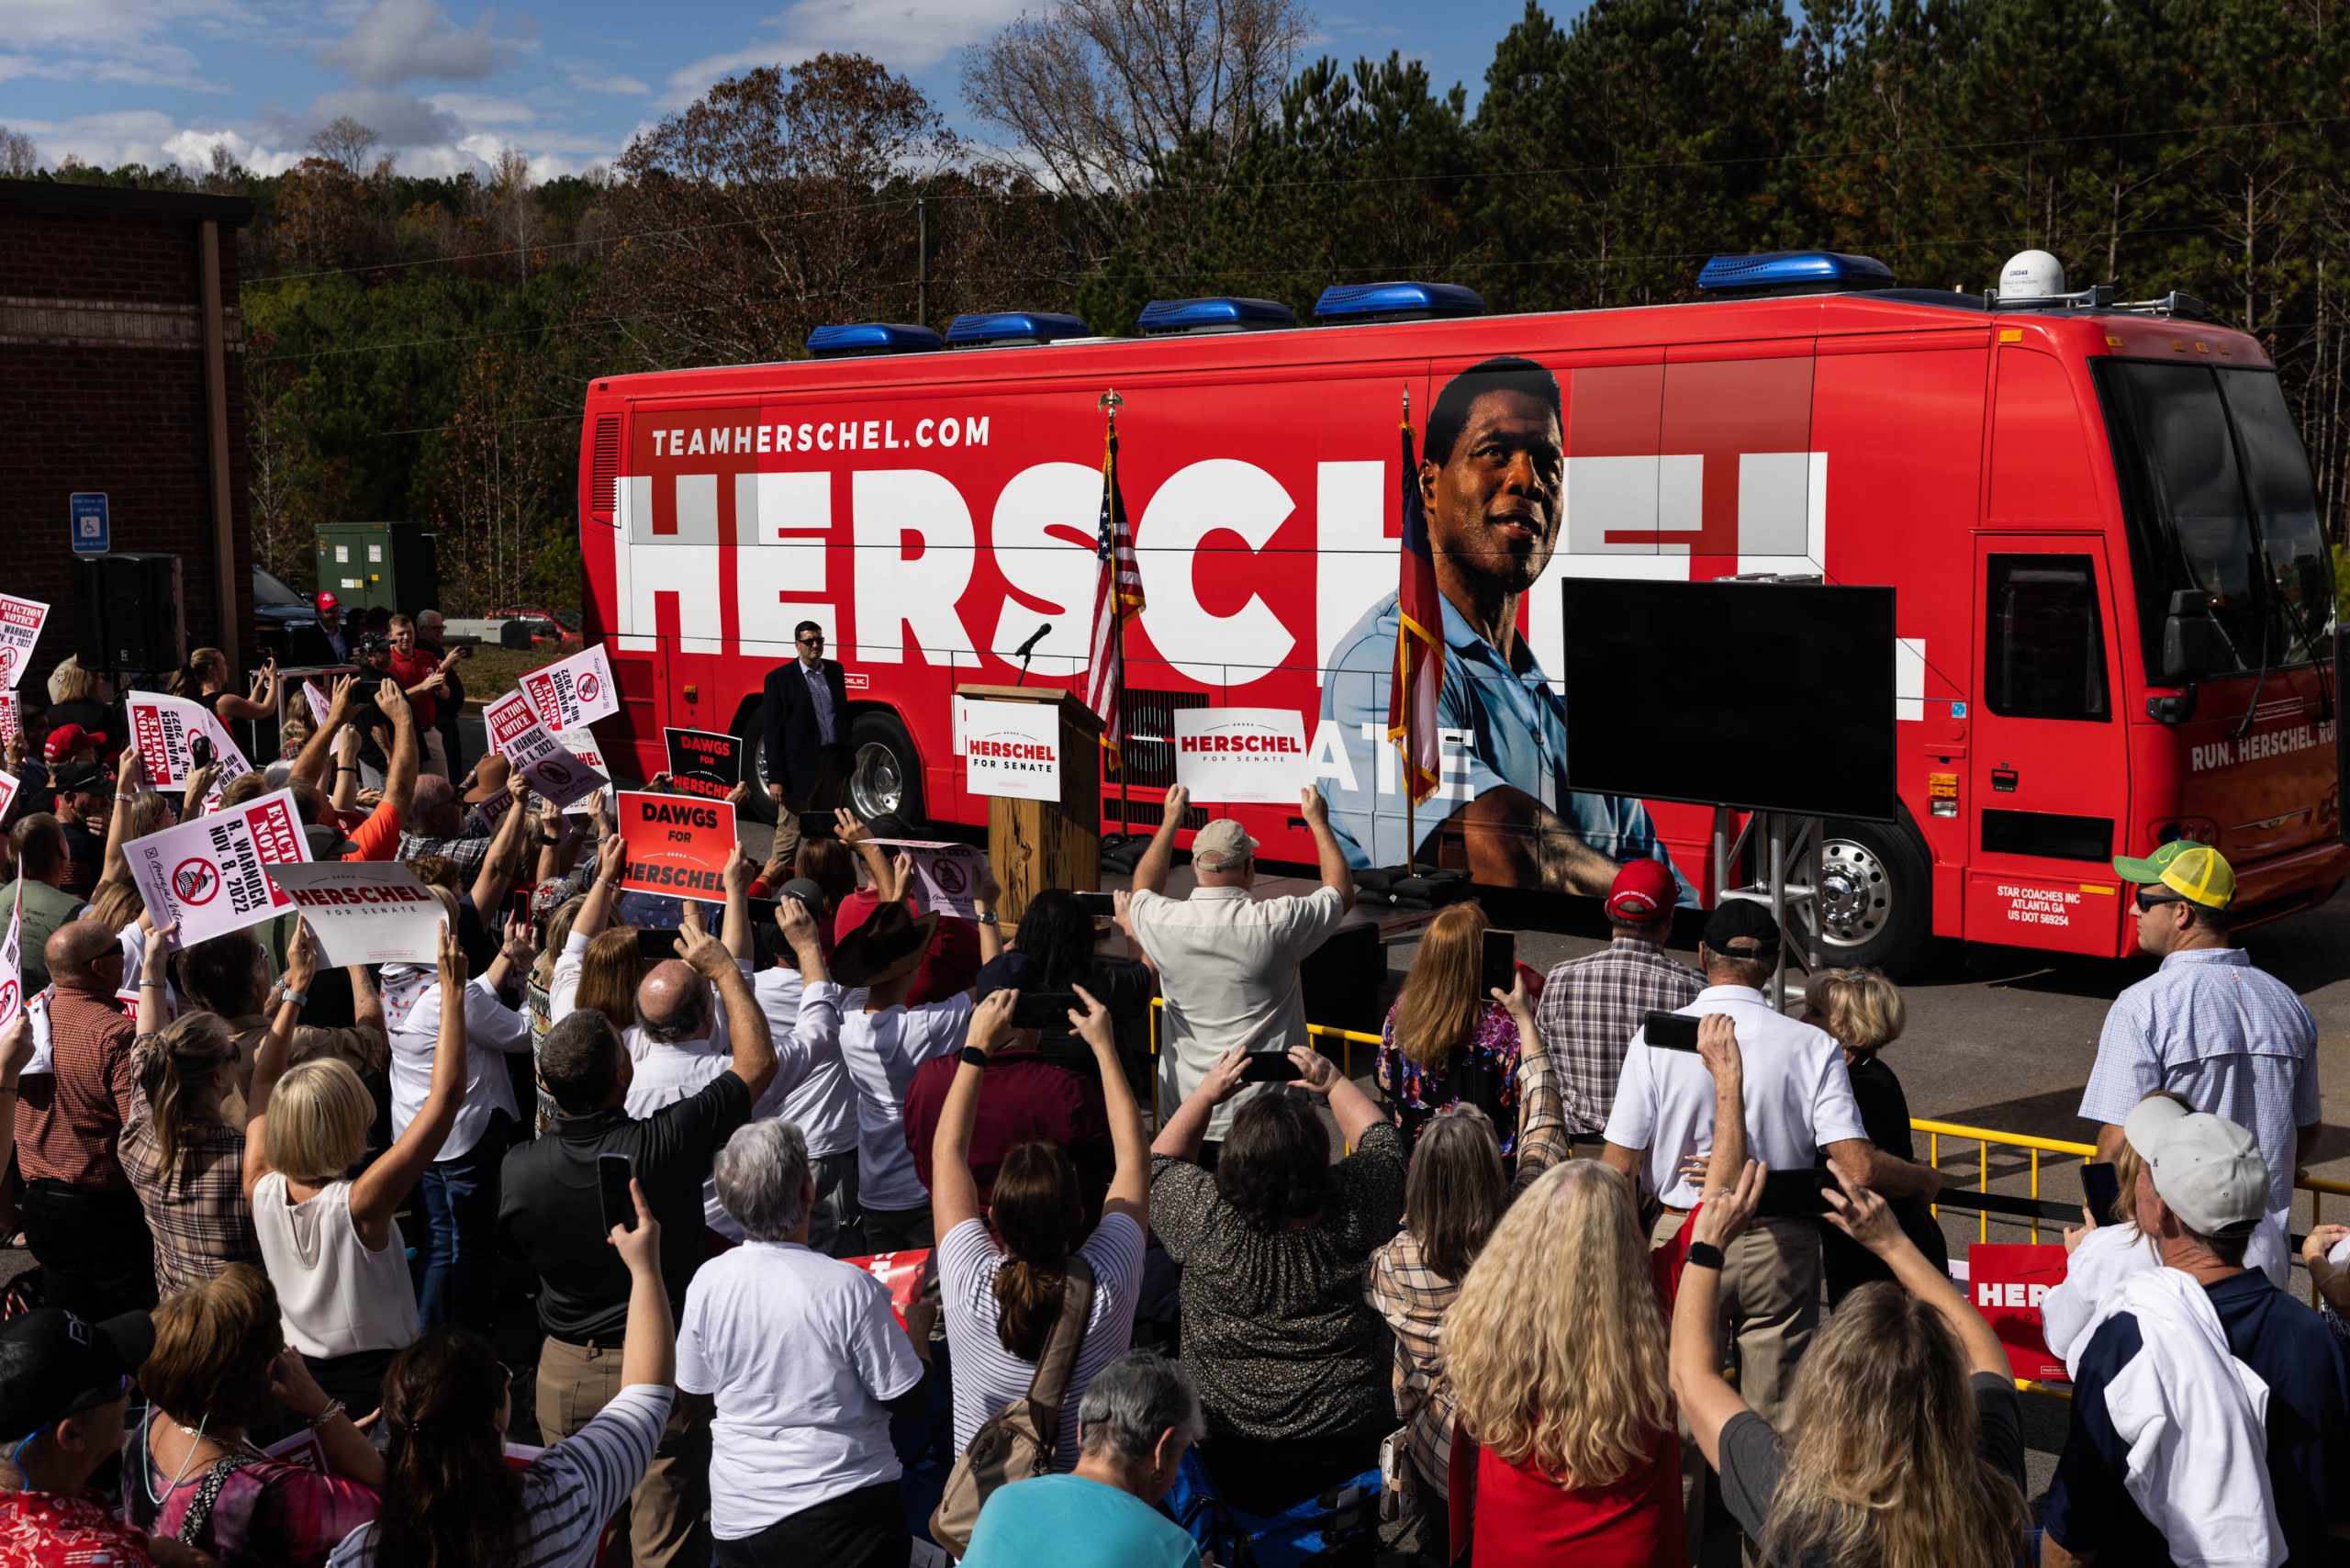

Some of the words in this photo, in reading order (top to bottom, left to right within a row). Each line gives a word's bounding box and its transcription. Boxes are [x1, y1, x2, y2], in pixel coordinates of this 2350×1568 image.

[652, 416, 990, 457] TEAMHERSCHEL.COM
[1, 600, 41, 619] EVICTION
[3, 611, 36, 626] NOTICE
[5, 624, 34, 639] WARNOCK
[17, 637, 31, 648] 2022
[561, 667, 574, 690] 2022
[542, 681, 559, 724] NOTICE
[552, 671, 570, 714] WARNOCK
[490, 698, 527, 729] EVICTION
[564, 715, 572, 725] R.
[570, 701, 580, 722] NOV.
[171, 711, 184, 738] 2022
[500, 712, 531, 739] NOTICE
[136, 709, 157, 781] EVICTION
[148, 717, 167, 773] NOTICE
[161, 710, 180, 766] WARNOCK
[506, 745, 517, 757] R.
[512, 726, 546, 754] WARNOCK
[533, 739, 555, 756] 2022
[680, 735, 731, 757] DAWGS
[1181, 735, 1302, 754] HERSCHEL
[2191, 741, 2234, 772] RUN.
[2238, 724, 2316, 763] HERSCHEL.
[699, 755, 715, 766] FOR
[969, 739, 1056, 762] HERSCHEL
[173, 769, 184, 780] R.
[973, 758, 996, 768] FOR
[1003, 760, 1053, 773] SENATE
[642, 801, 719, 829] DAWGS
[226, 818, 243, 836] R.
[266, 802, 301, 863] EVICT
[667, 830, 692, 844] FOR
[208, 824, 231, 858] NOV.
[220, 859, 237, 877] 8,
[232, 836, 268, 911] WARNOCK
[151, 860, 173, 901] Georgia
[226, 878, 250, 915] 2022
[290, 885, 431, 906] HERSCHEL
[1997, 885, 2020, 898] STAR
[2020, 888, 2064, 902] COACHES
[2065, 892, 2080, 904] INC
[2011, 898, 2051, 912] ATLANTA
[2052, 902, 2065, 913] GA
[362, 905, 419, 915] SENATE
[2008, 909, 2020, 921] US
[2021, 911, 2039, 923] DOT
[2040, 913, 2069, 926] 569254
